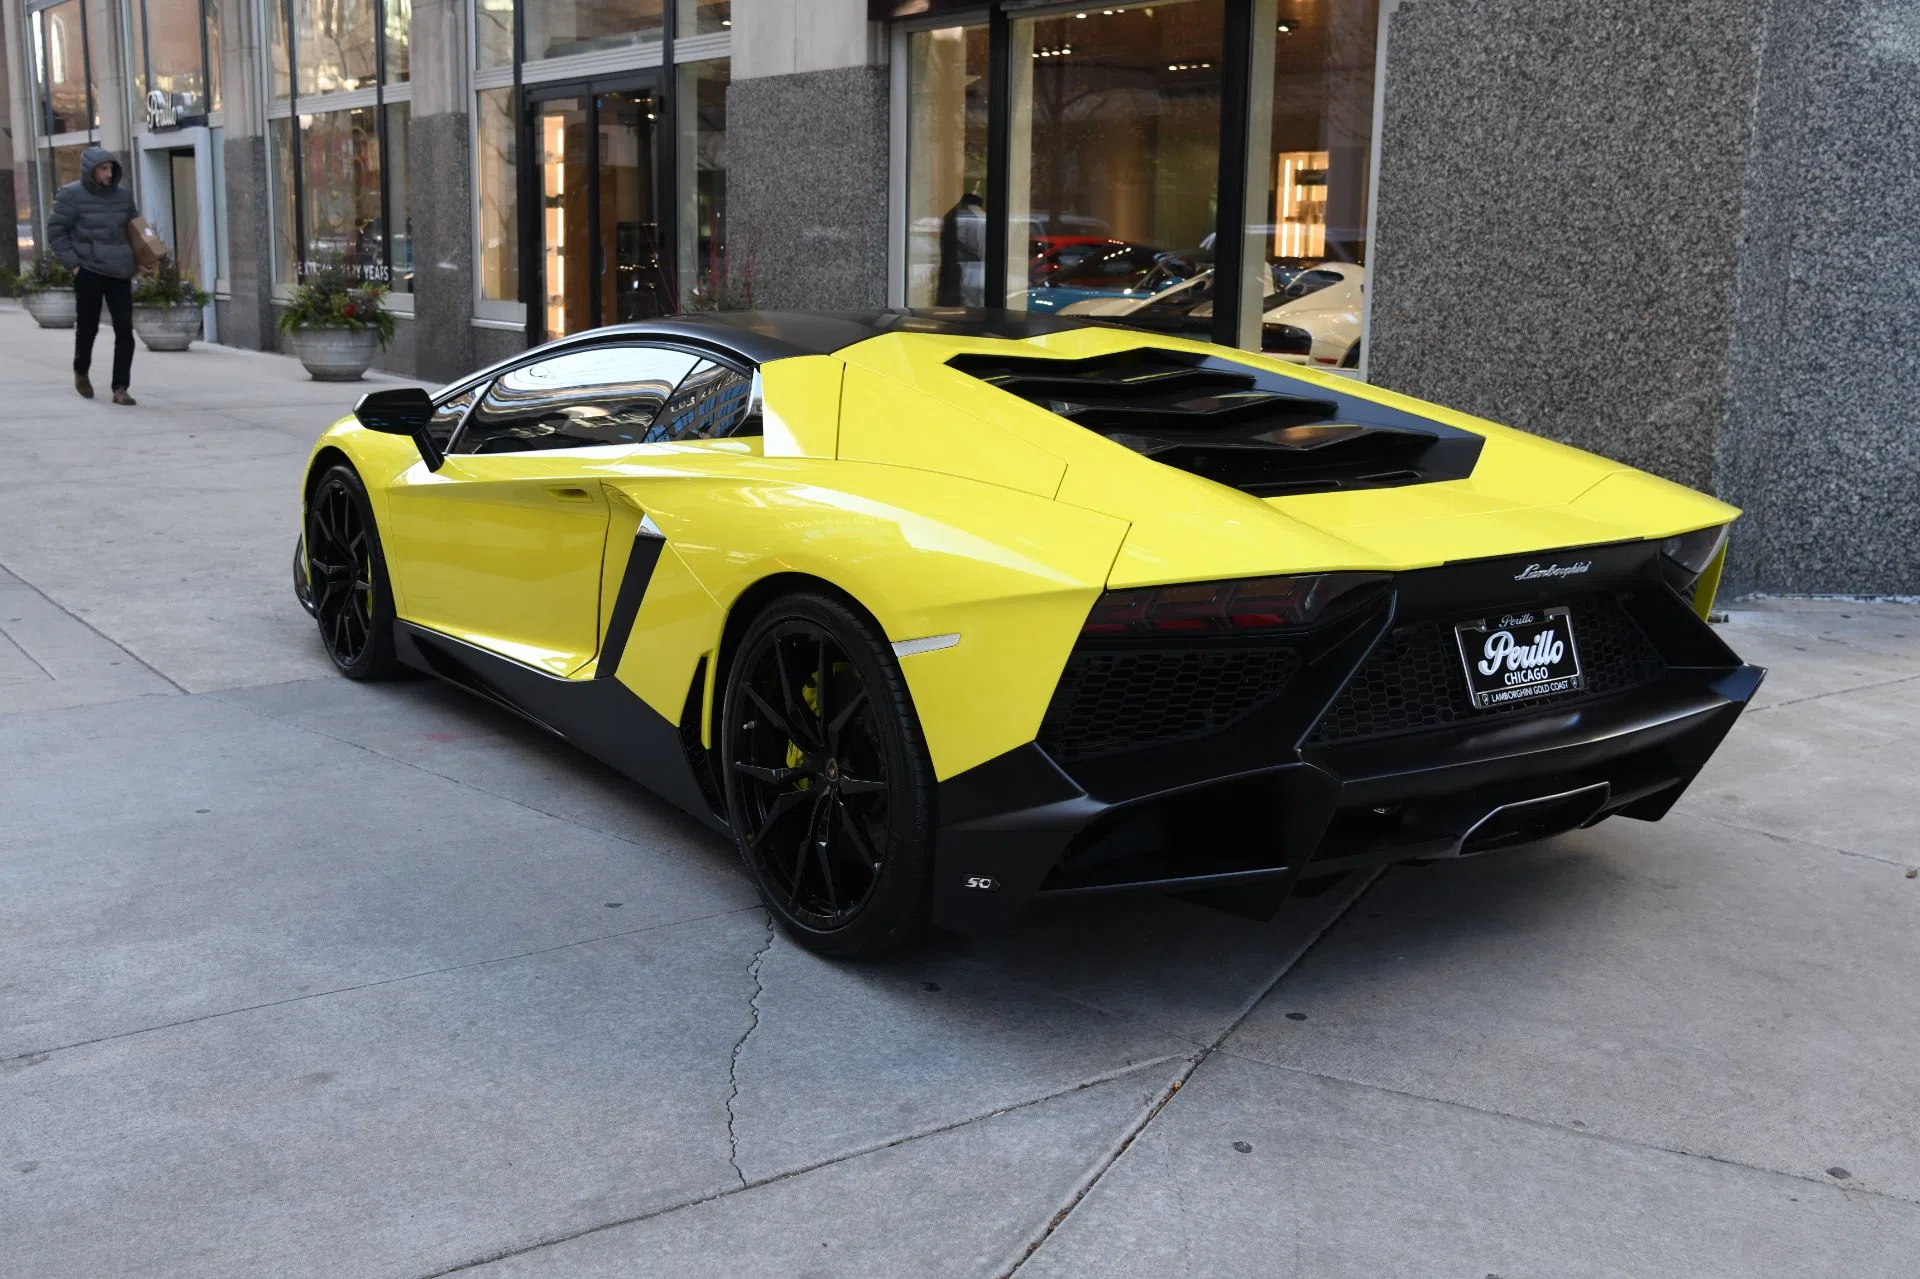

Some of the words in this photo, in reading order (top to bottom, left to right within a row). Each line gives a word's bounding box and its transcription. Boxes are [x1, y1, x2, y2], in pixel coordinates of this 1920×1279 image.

[1513, 561, 1592, 581] Lamborghini
[1499, 613, 1534, 628] Perillo
[1478, 629, 1564, 676] Perillo
[1504, 666, 1549, 686] CHICAGO
[1491, 686, 1533, 703] LAMBORGHINI
[1533, 682, 1550, 696] GOLD
[1551, 680, 1569, 692] COAST
